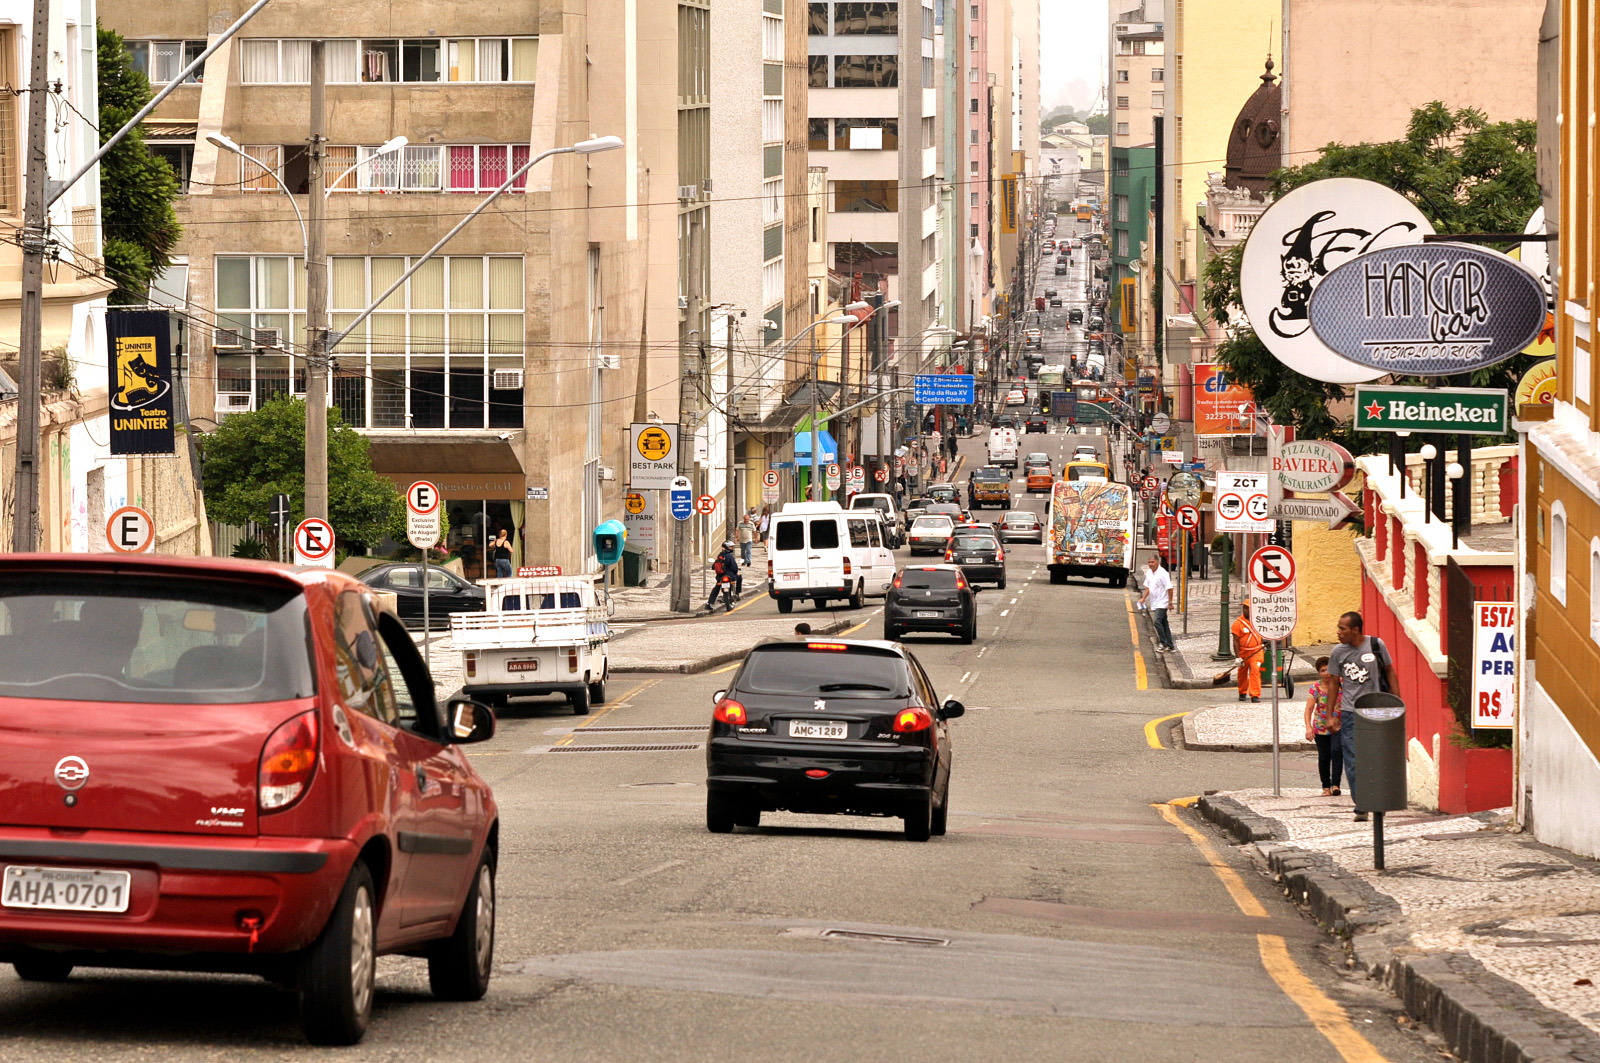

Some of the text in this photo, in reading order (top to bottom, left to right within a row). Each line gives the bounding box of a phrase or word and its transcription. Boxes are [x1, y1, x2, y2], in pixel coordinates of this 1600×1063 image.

[1364, 262, 1488, 316] HANGAR
[1430, 304, 1487, 344] bar
[1382, 346, 1428, 358] TEMPLO
[1431, 346, 1447, 358] DO
[1450, 346, 1482, 359] ROCK
[1388, 400, 1498, 422] Heineken
[114, 418, 168, 430] UNINTER
[1281, 444, 1331, 461] PIZZARIA
[1272, 457, 1339, 473] BAVIERA
[437, 482, 482, 492] Registro
[485, 482, 512, 491] Civil
[767, 474, 774, 484] E
[1233, 479, 1258, 488] ZCT
[1278, 472, 1333, 490] RESTAURANTE
[417, 488, 429, 507] E
[1252, 501, 1259, 510] 7
[1182, 510, 1193, 525] E
[1272, 505, 1339, 517] AR CONDICIONADO
[122, 516, 138, 546] E
[306, 527, 322, 551] E
[1262, 554, 1282, 583] E
[794, 726, 843, 736] AMC-1289
